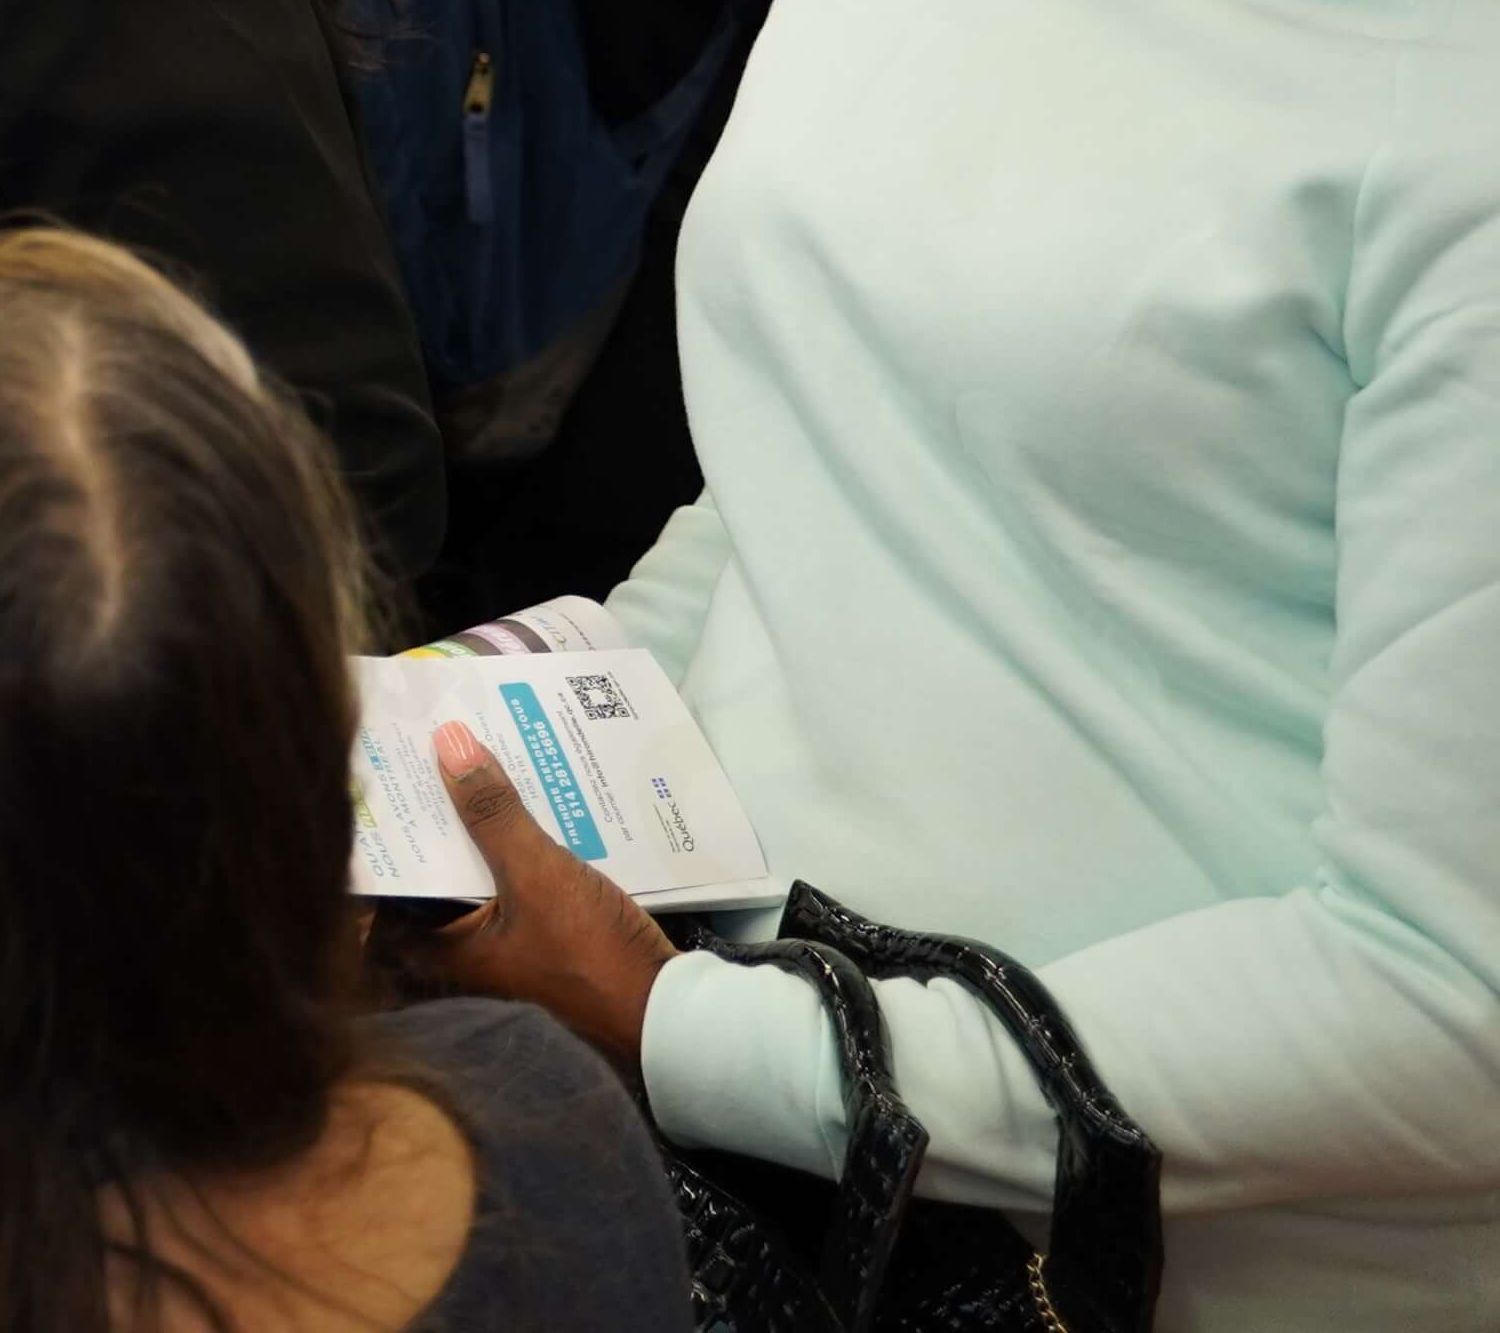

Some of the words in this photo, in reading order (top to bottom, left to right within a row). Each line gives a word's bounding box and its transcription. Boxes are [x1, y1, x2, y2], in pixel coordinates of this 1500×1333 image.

[510, 698, 530, 731] VOUS
[527, 734, 555, 783] RENDEZ
[533, 720, 571, 788] 281-5696
[551, 787, 581, 846] PRENDRE
[564, 791, 584, 819] 514
[667, 800, 695, 852] Québec
